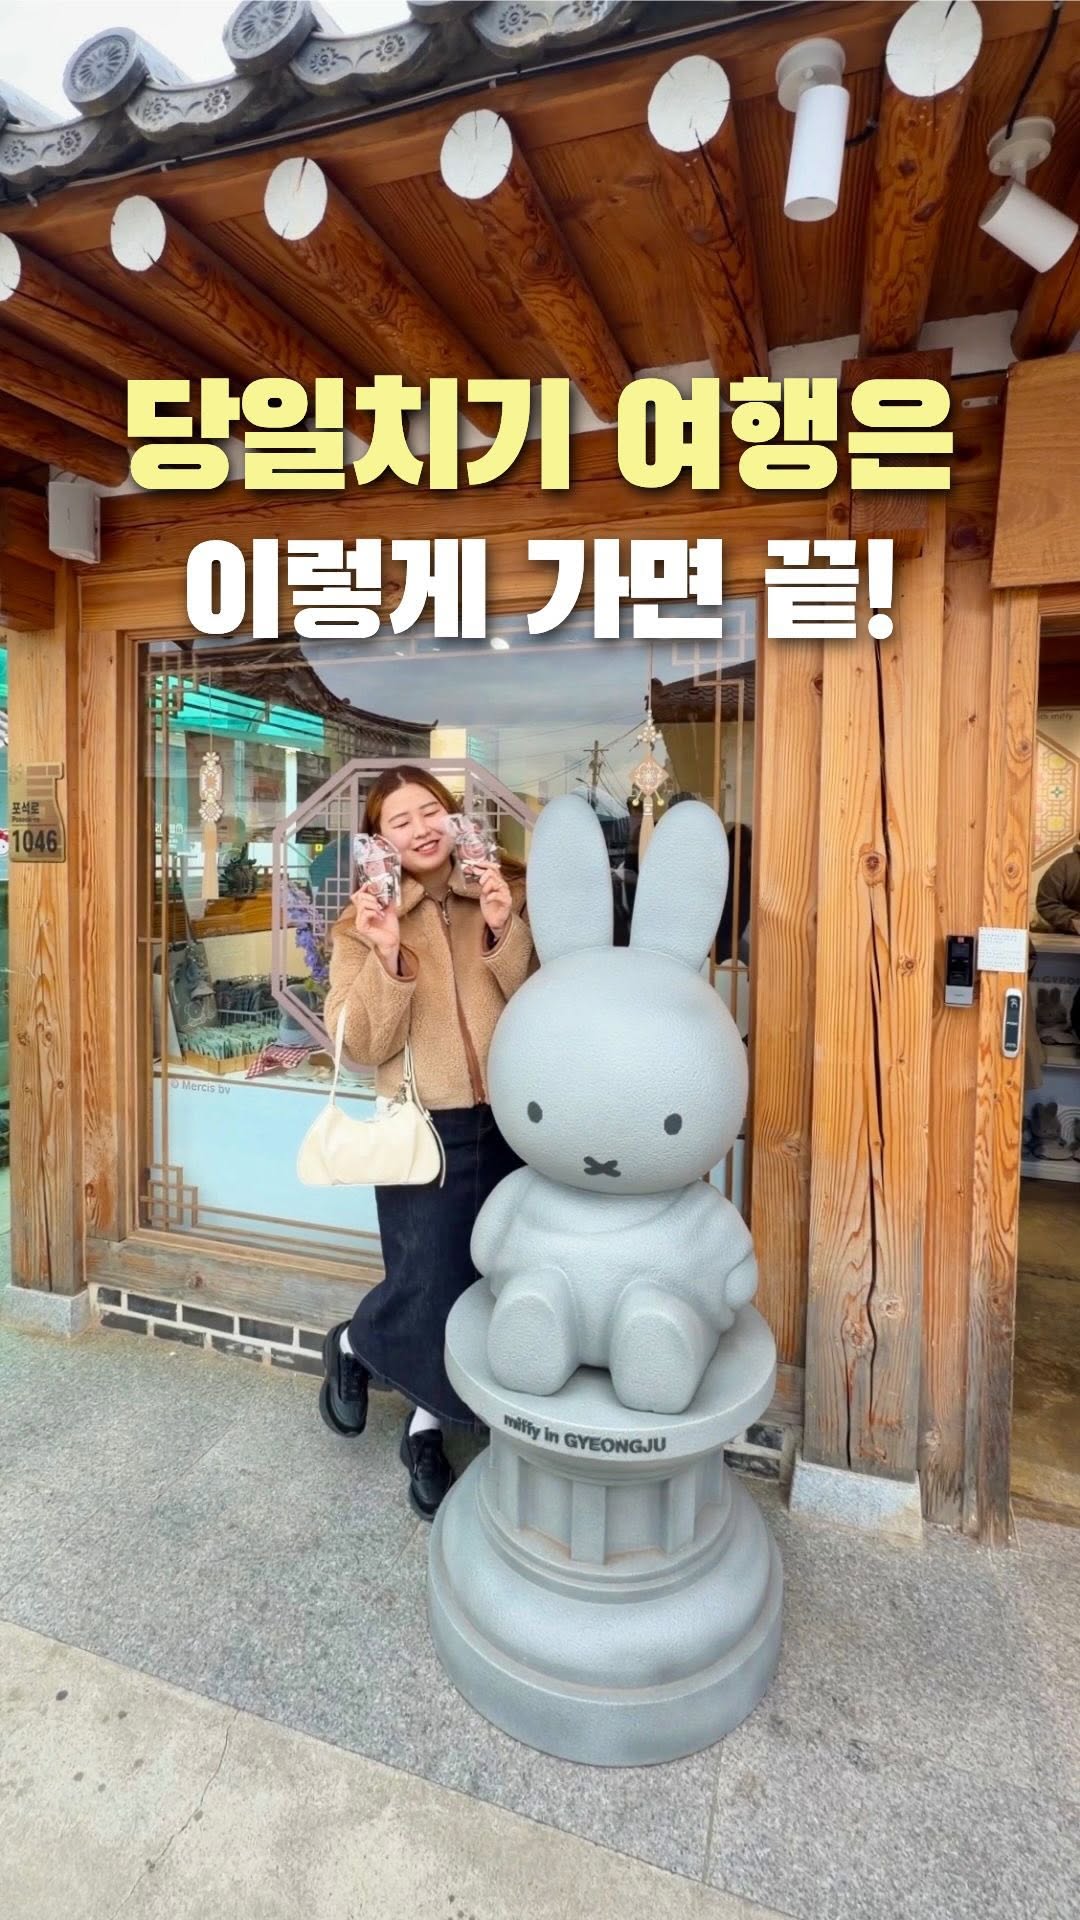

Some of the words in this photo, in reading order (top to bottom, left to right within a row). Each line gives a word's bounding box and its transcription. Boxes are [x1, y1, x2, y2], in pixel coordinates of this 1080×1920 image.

[11, 801, 40, 815] 포석로
[12, 829, 58, 853] 1046
[182, 1080, 215, 1093] Mercis
[218, 1086, 231, 1095] bv
[504, 1414, 540, 1440] miffy
[545, 1426, 559, 1444] in
[564, 1432, 667, 1454] GYEONGJU
